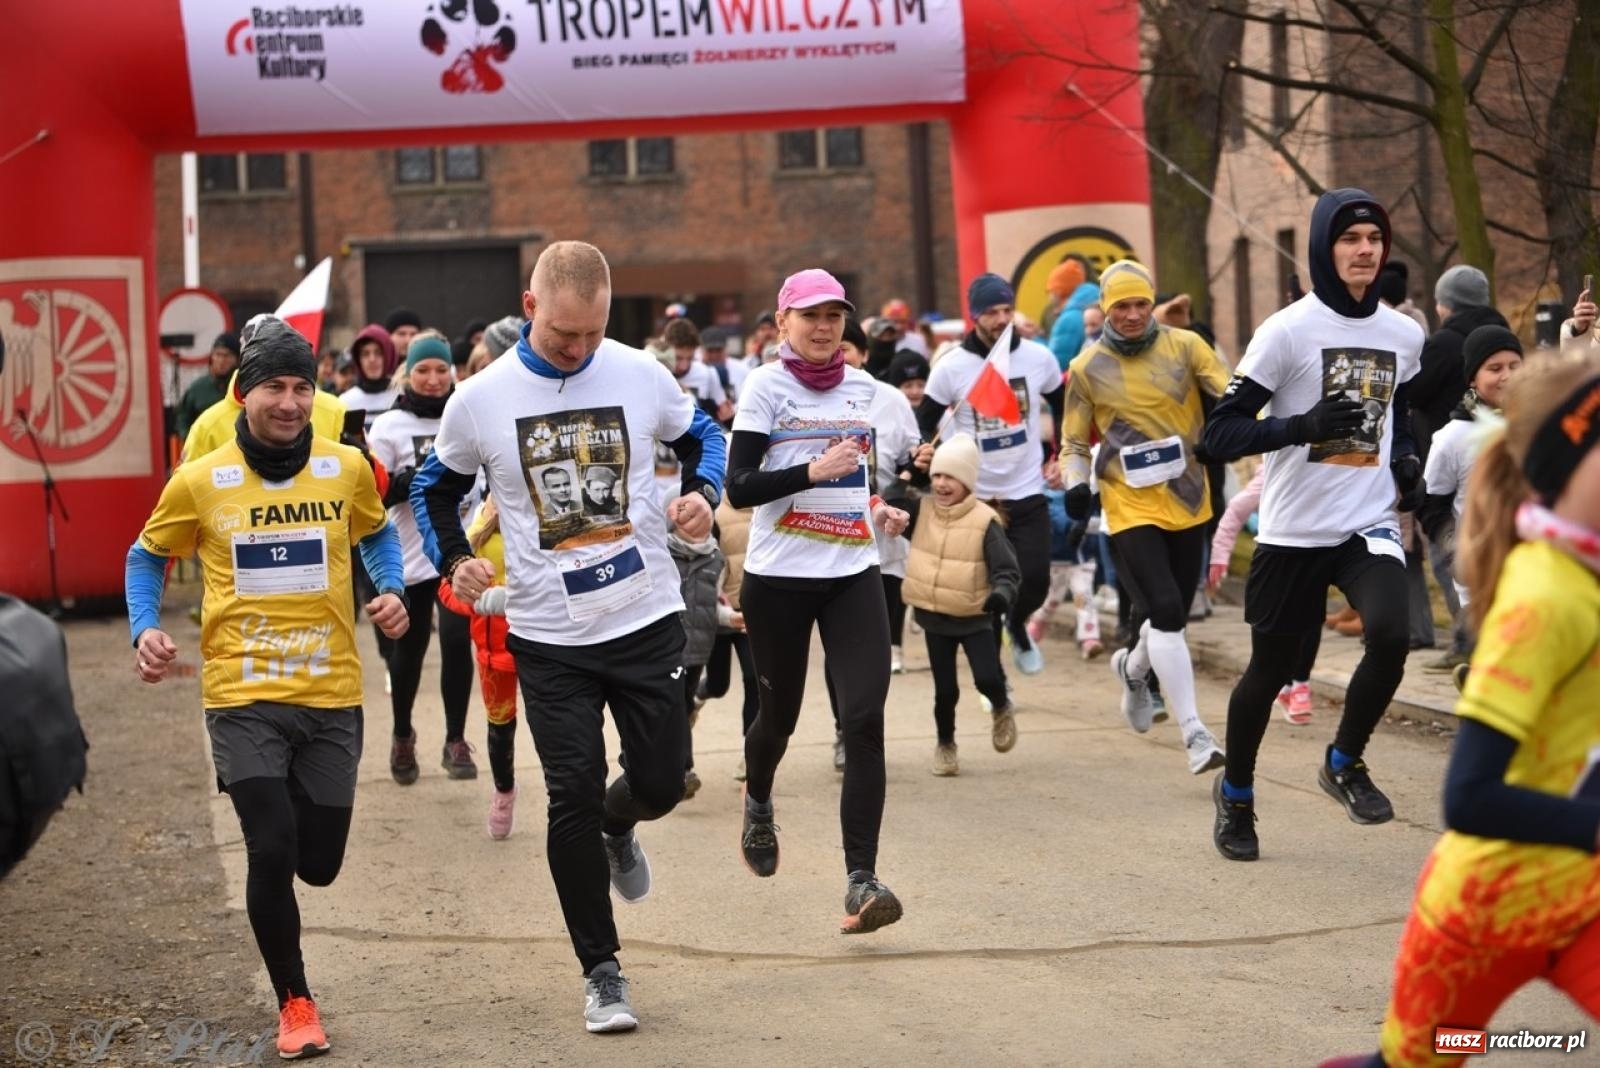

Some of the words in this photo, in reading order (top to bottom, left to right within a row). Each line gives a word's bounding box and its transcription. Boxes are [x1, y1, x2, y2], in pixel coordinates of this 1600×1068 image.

[252, 5, 363, 28] Raciborskie
[572, 55, 614, 69] BIEG
[619, 52, 688, 69] PAMIĘCI
[694, 47, 788, 64] ŻOŁNIERZY
[794, 41, 896, 59] WYKLĘTYCH
[257, 56, 326, 81] Kultury
[1144, 450, 1160, 464] 38
[250, 500, 344, 527] FAMILY
[270, 547, 288, 561] 12
[596, 564, 616, 582] 39
[243, 647, 331, 682] LIFE
